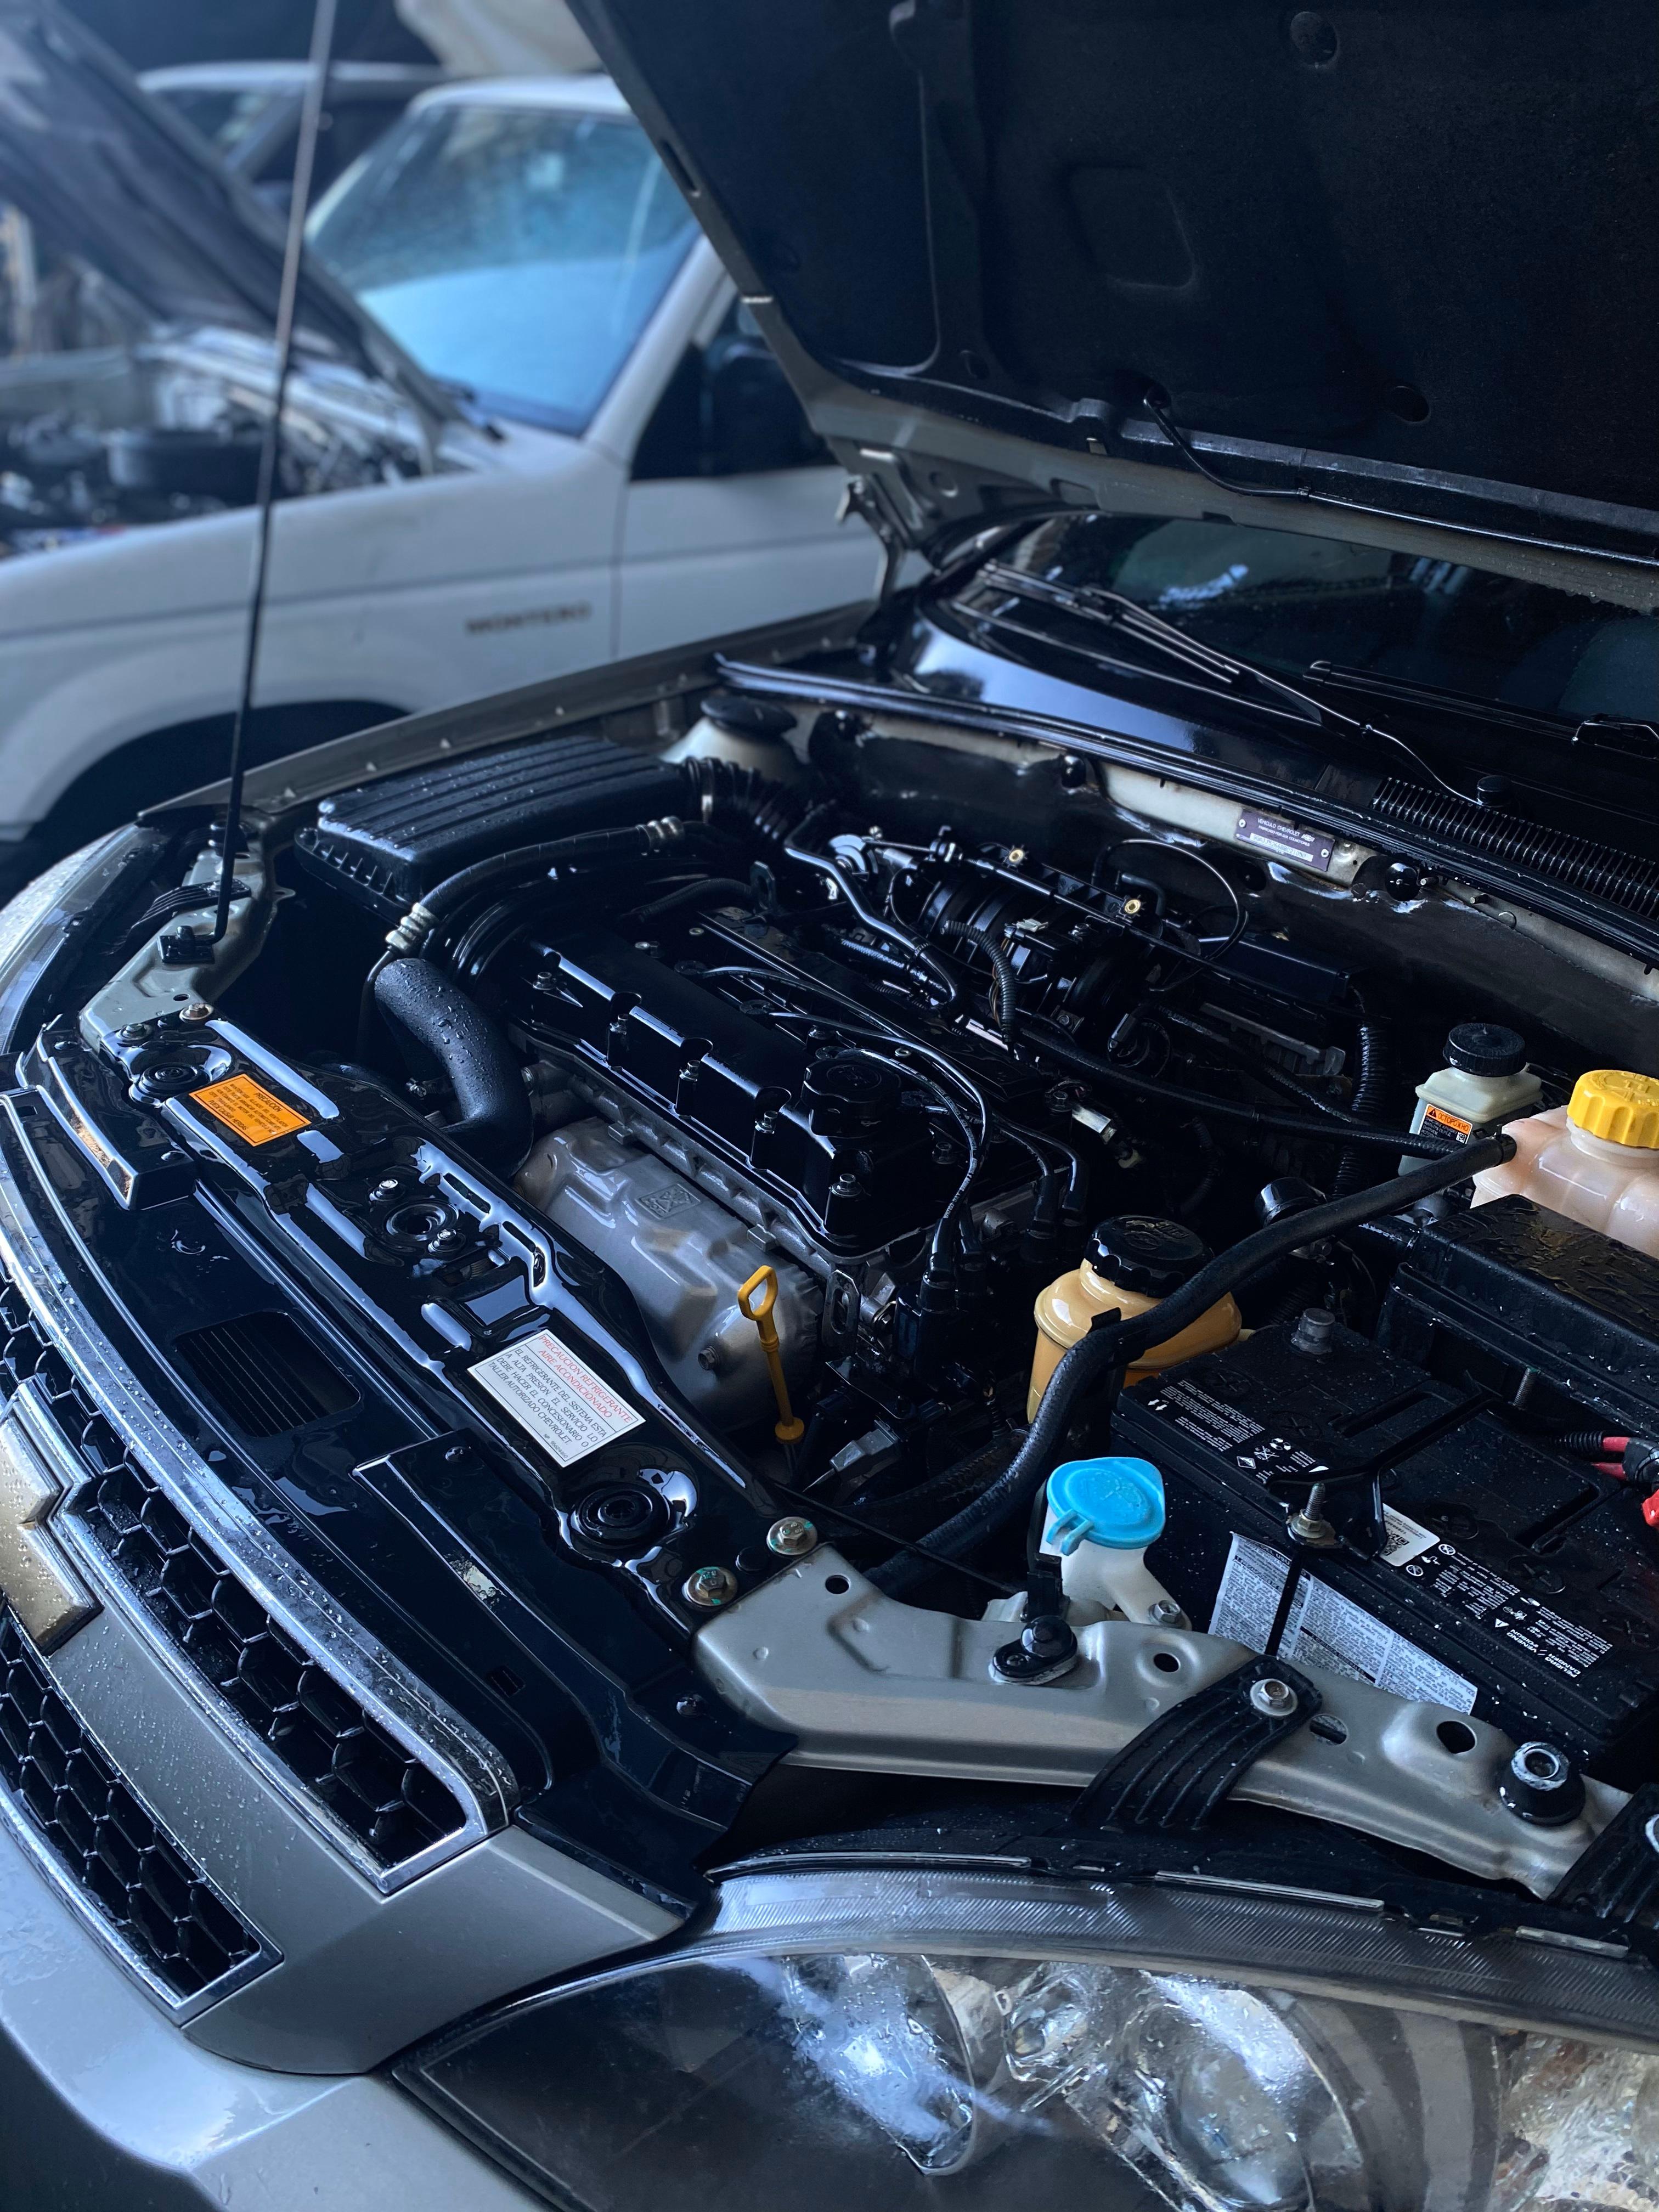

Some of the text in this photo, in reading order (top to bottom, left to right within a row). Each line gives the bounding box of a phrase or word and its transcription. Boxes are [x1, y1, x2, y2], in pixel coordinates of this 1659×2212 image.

[1257, 818, 1300, 837] VEHICULO CHEVROLET
[1258, 825, 1276, 834] FABRICADO
[207, 1099, 249, 1130] PUEDE CAUSAR HERIDAS
[253, 1092, 283, 1112] PRECAUCION
[1437, 1113, 1469, 1131] ОСТОРОЖНО
[487, 1362, 509, 1381] TALLER
[504, 1379, 540, 1413] AUTORIZADO
[496, 1357, 514, 1372] DEBE
[510, 1372, 532, 1390] HACER
[528, 1390, 540, 1398] EL
[536, 1397, 583, 1441] CONCESIONARIO
[514, 1348, 608, 1437] EL REFRIGERANTE DEL SISTEMA ESTA
[538, 1335, 633, 1423] PRECAUCION REFRIGERANTE
[538, 1348, 613, 1418] AIRE ACONDICIONADO
[511, 1359, 527, 1372] ALTA
[550, 1397, 562, 1406] EL
[560, 1406, 588, 1432] SERVICIO
[586, 1432, 599, 1442] LO
[1506, 1632, 1537, 1653] VENENO
